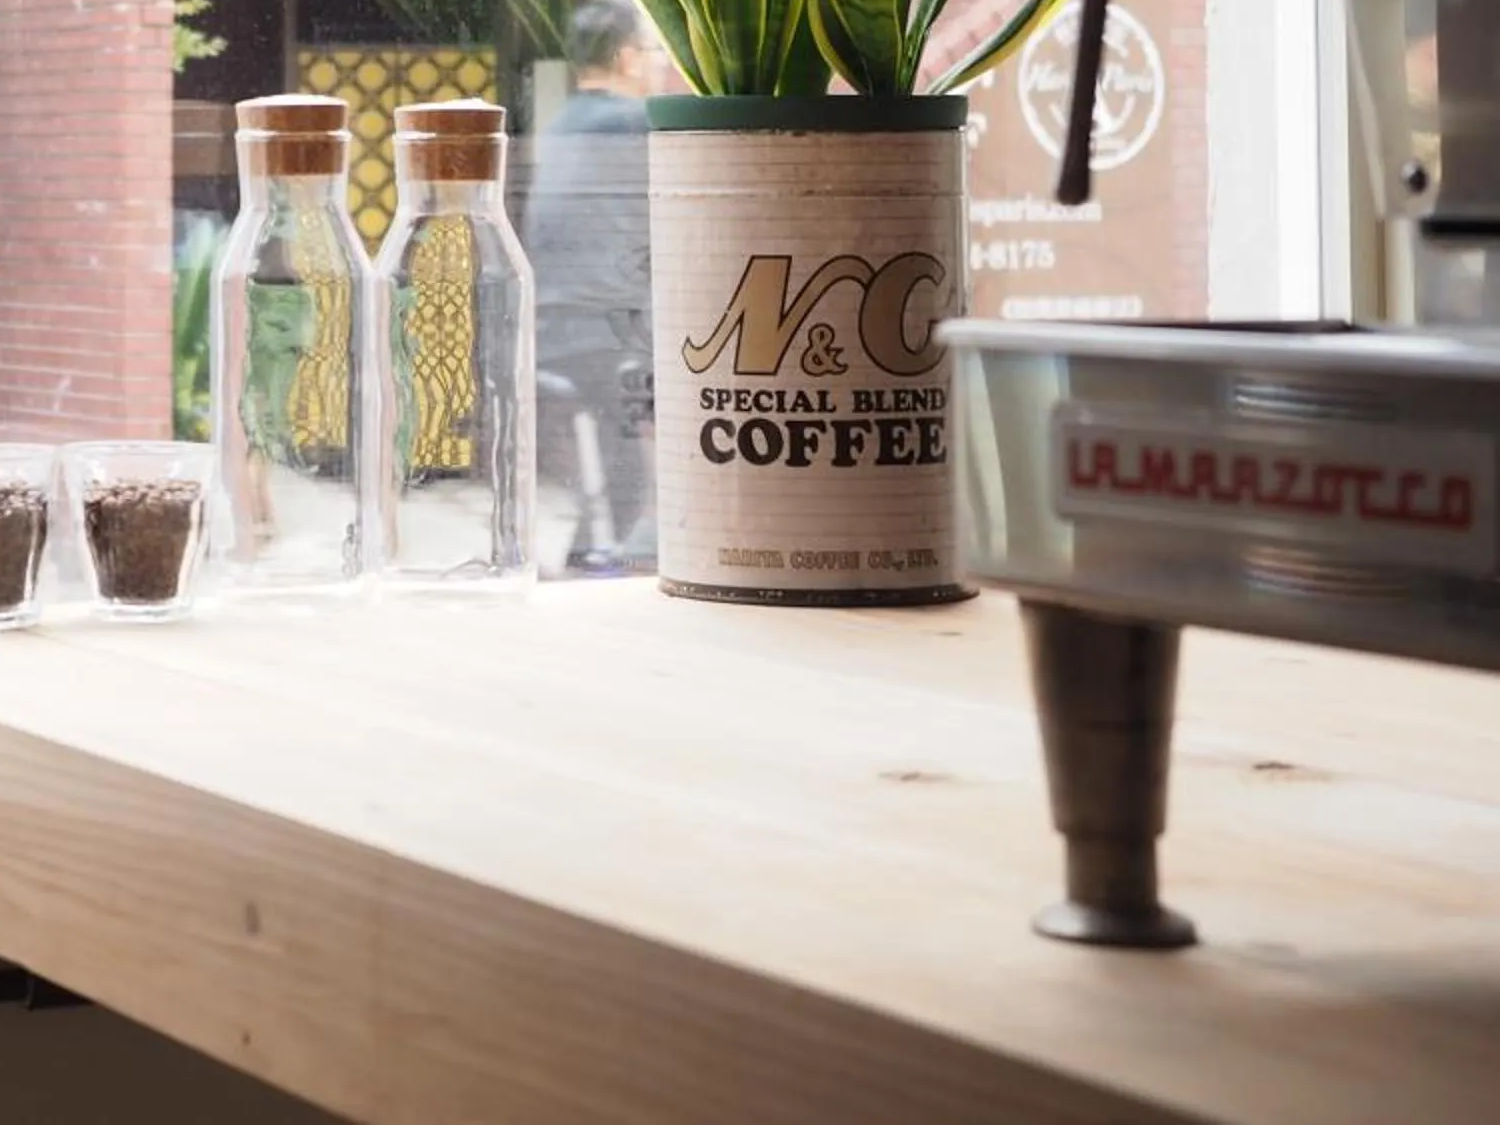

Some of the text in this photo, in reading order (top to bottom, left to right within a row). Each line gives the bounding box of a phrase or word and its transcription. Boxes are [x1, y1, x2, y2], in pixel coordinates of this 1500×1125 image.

[699, 387, 947, 413] SPECIAL BLEND
[699, 417, 948, 467] COFFEE
[790, 549, 859, 571] COFFEE
